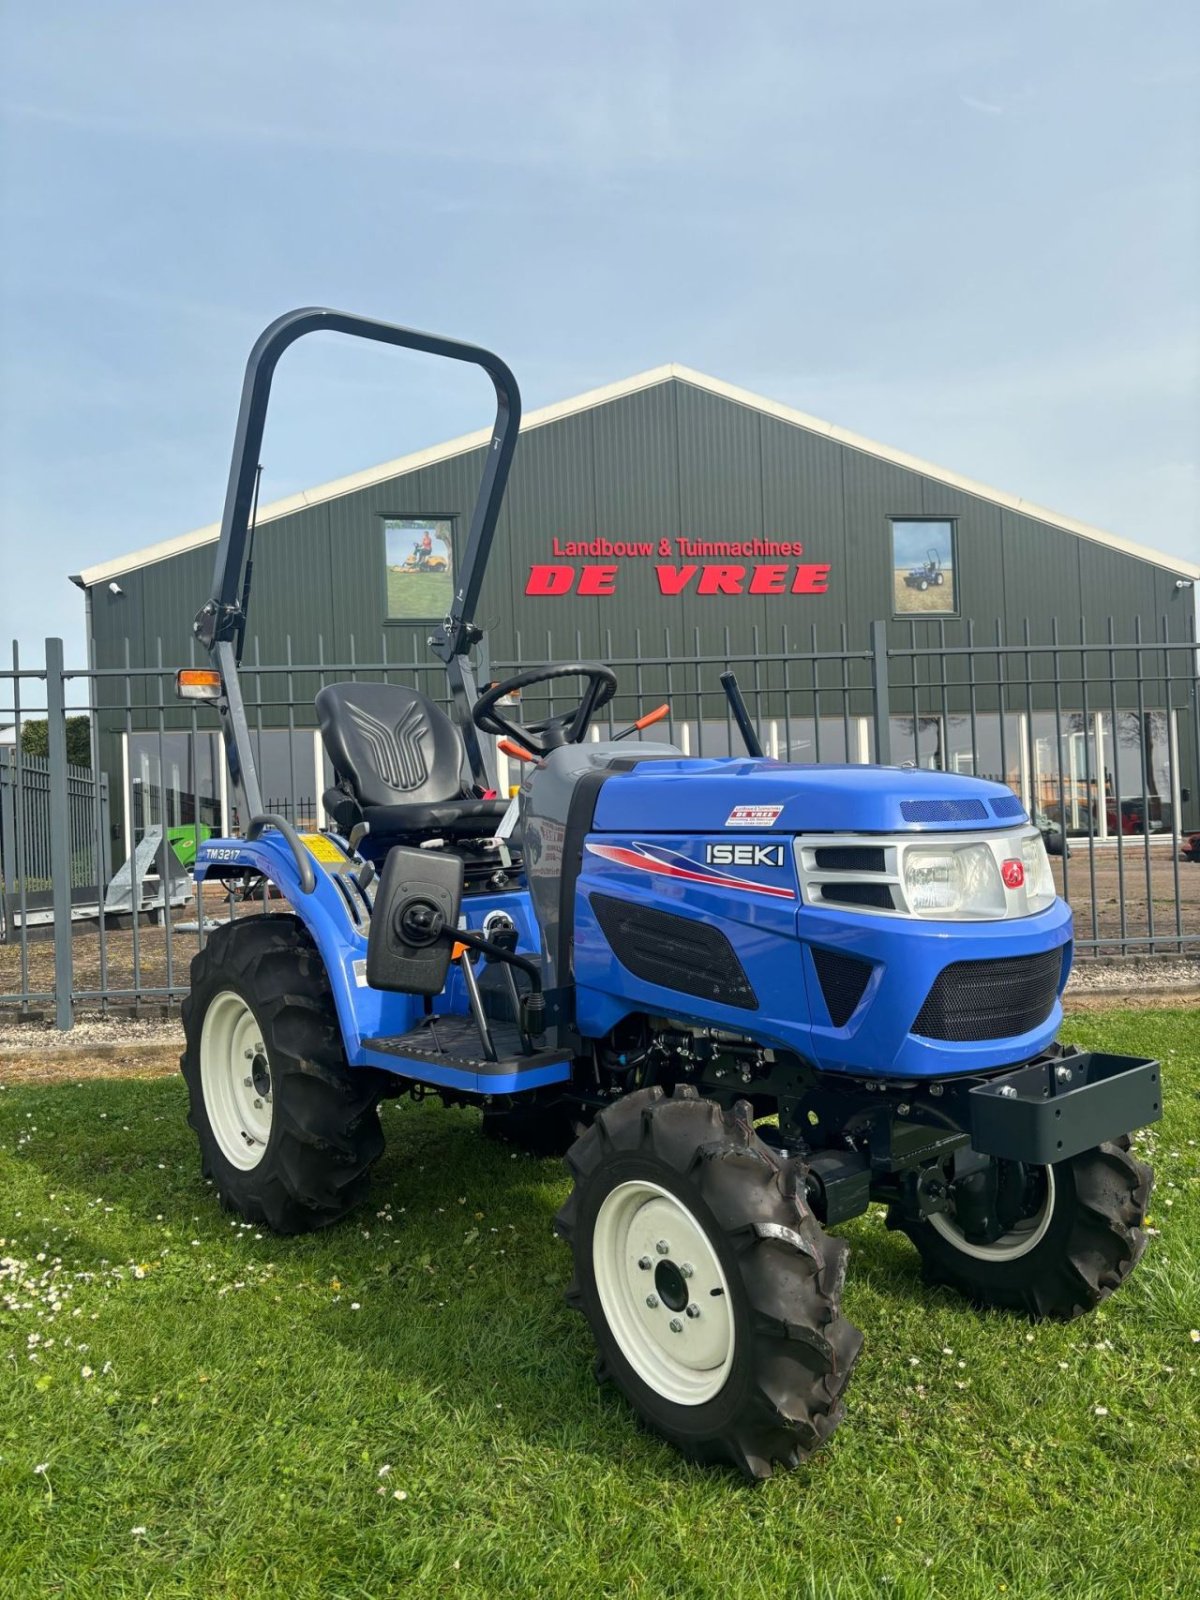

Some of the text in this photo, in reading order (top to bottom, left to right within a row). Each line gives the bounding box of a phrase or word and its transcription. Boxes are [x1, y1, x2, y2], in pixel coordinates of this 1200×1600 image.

[553, 537, 803, 556] Landbouw & Tuinmachines
[525, 564, 831, 595] DE VREE
[206, 848, 241, 860] TM3217
[706, 844, 784, 866] ISEKI
